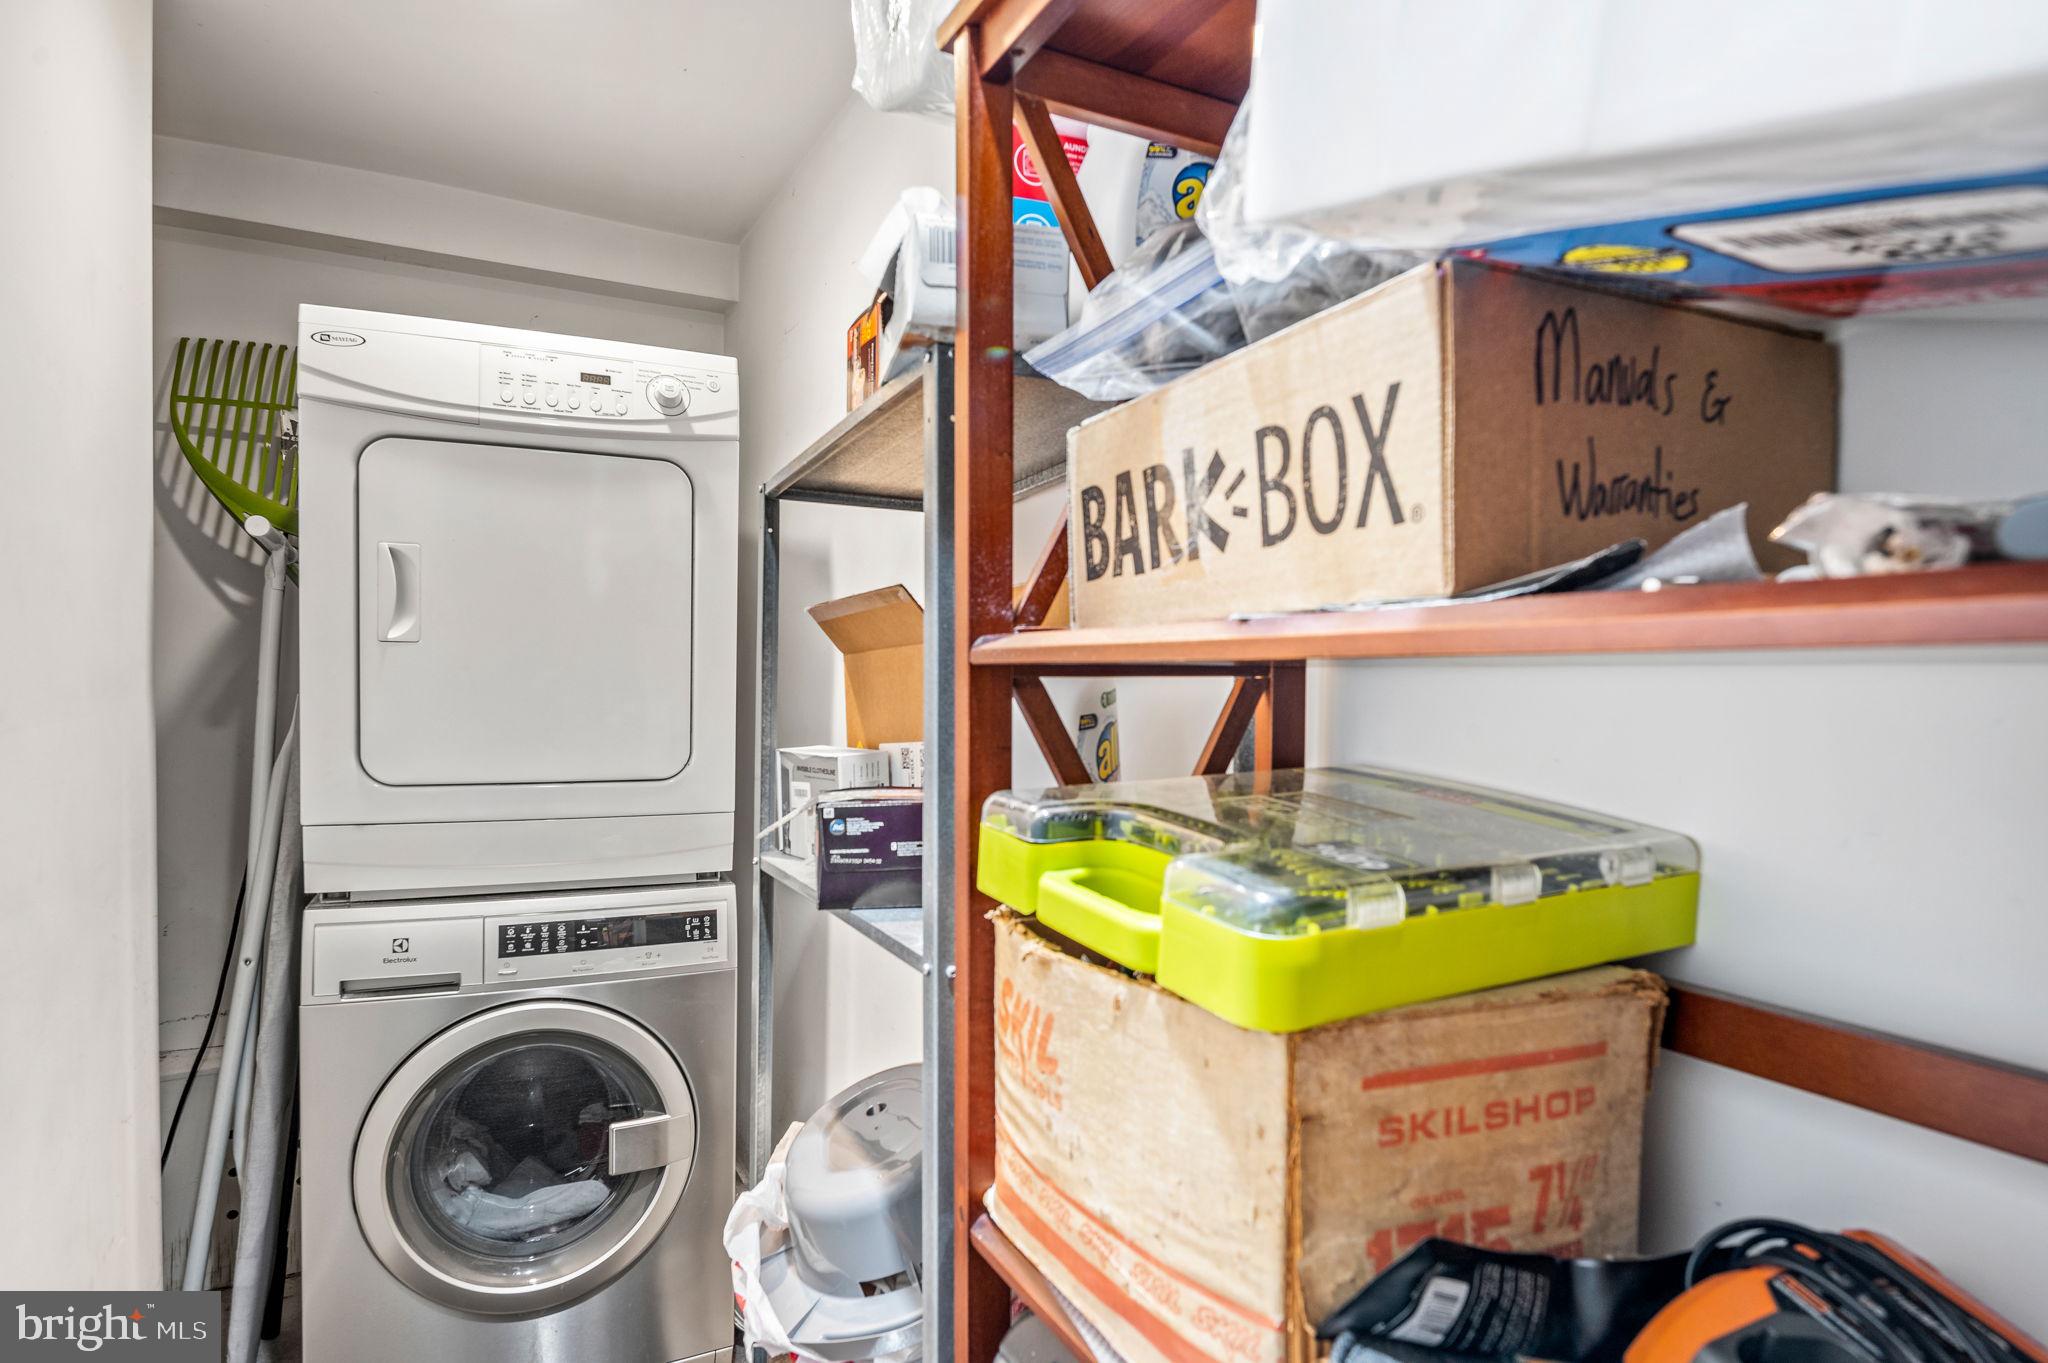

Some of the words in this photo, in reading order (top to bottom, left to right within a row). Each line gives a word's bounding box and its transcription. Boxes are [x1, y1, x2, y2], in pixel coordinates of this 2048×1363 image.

[1701, 368, 1733, 426] &
[1081, 447, 1231, 582] BARK
[1255, 382, 1405, 548] BOX
[1556, 435, 1700, 523] Warranties
[1377, 1086, 1597, 1148] SKILSHOP
